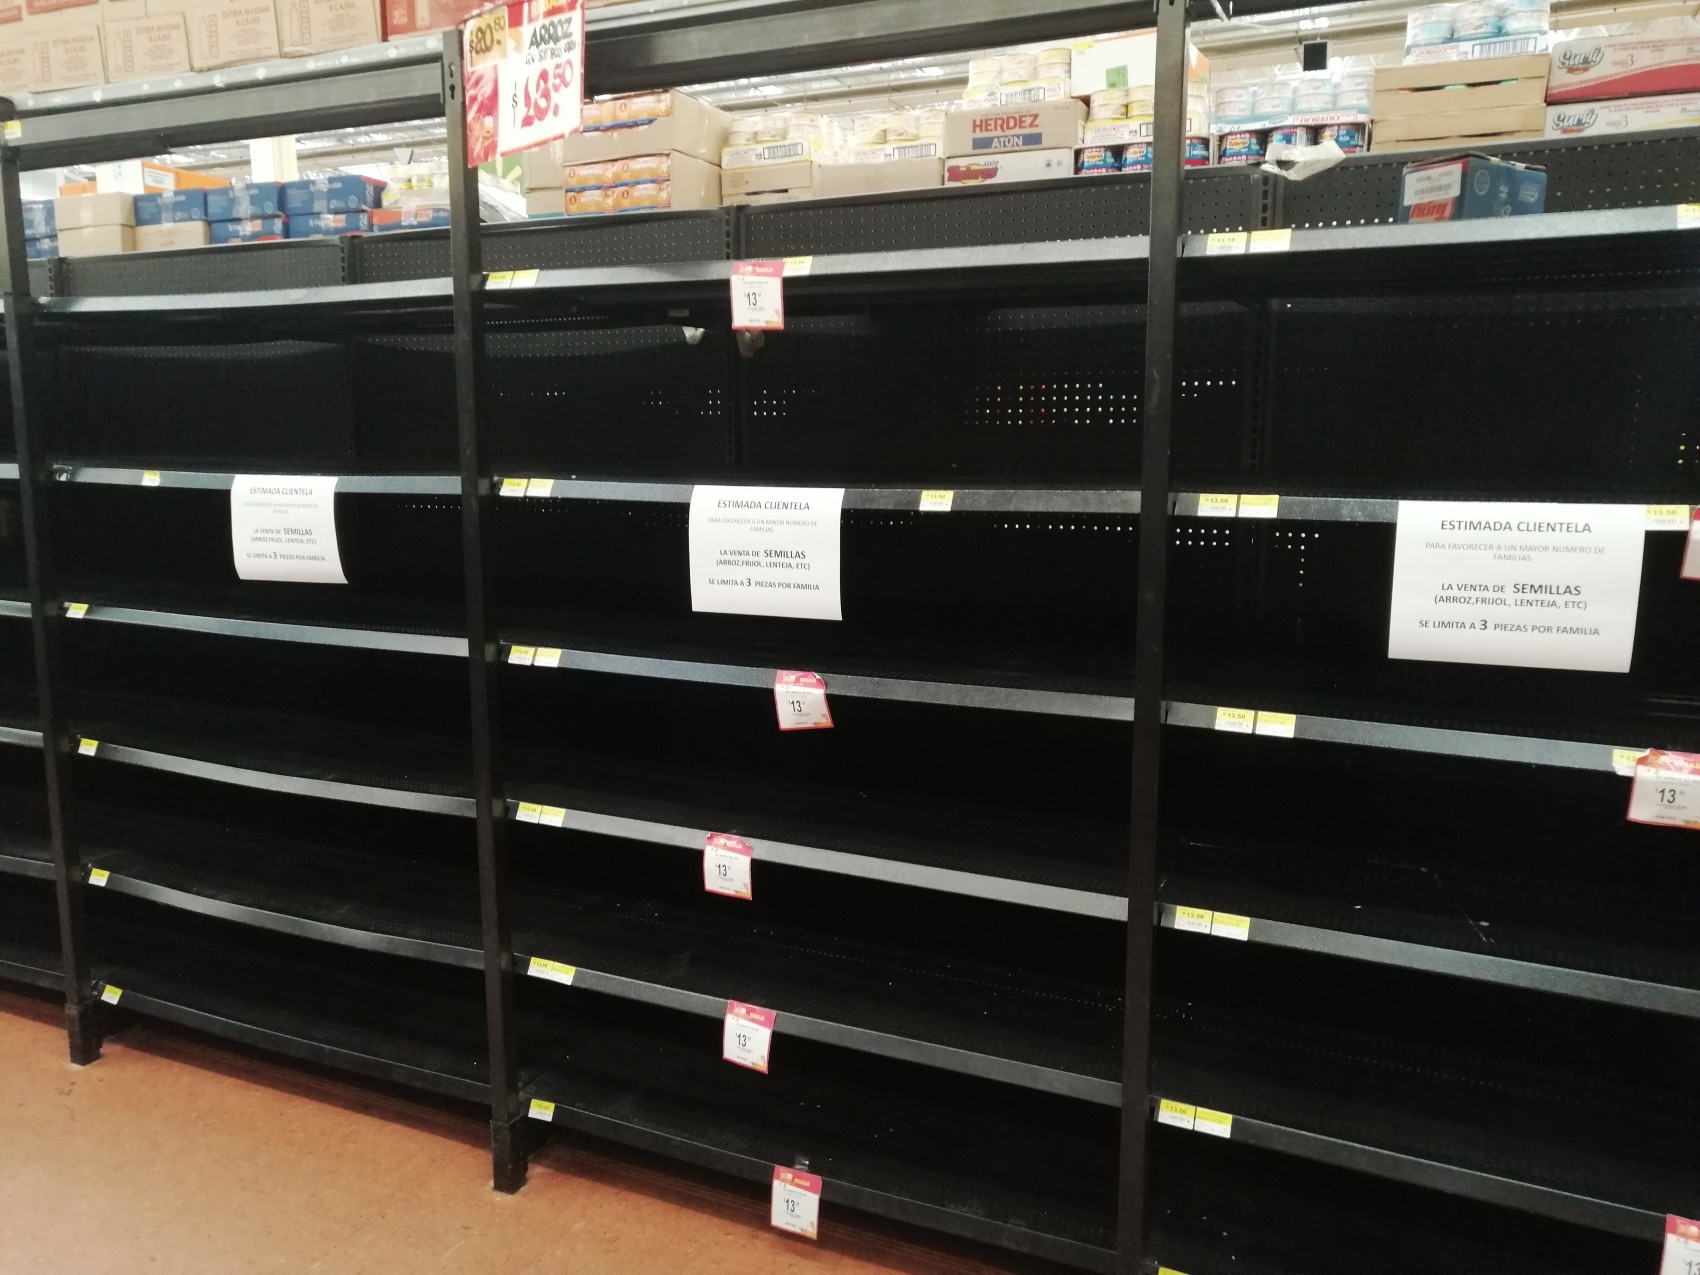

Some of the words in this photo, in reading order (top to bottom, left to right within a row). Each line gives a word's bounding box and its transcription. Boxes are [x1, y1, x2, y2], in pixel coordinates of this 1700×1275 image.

[529, 16, 572, 50] ARROZ
[972, 114, 1039, 133] HERDEZ
[992, 136, 1022, 148] ATÚN
[250, 487, 280, 495] ESTIMADA
[282, 487, 313, 495] CLIENTELA
[718, 500, 762, 509] ESTIMADA
[765, 501, 810, 510] CLIENTELA
[283, 528, 312, 536] SEMILLAS
[1440, 519, 1512, 532] ESTIMADA
[1517, 520, 1592, 533] CLIENTELA
[1425, 542, 1446, 550] PARA
[1448, 543, 1494, 551] FAVORECER
[1504, 544, 1517, 552] UN
[1519, 544, 1550, 553] MAYOR
[1552, 545, 1592, 554] NUMERO
[1594, 546, 1606, 554] DE
[764, 550, 806, 559] SEMILLAS
[1494, 554, 1532, 562] FAMILIAS
[796, 563, 810, 571] ETC)
[746, 578, 751, 586] 3
[1442, 583, 1454, 591] LA
[1456, 583, 1490, 592] VENTA
[1492, 584, 1506, 593] DE
[1512, 583, 1582, 596] SEMILLAS
[1434, 595, 1511, 607] (ARROZ,FRIJOL,
[1514, 598, 1561, 609] LENTEJA,
[1564, 600, 1588, 611] ETC)
[1418, 619, 1430, 628] SE
[1432, 620, 1467, 630] LIMITA
[1469, 622, 1476, 630] A
[1479, 620, 1488, 630] 3
[1494, 623, 1528, 633] PIEZAS
[1531, 624, 1553, 634] POR
[1556, 626, 1600, 636] FAMILIA
